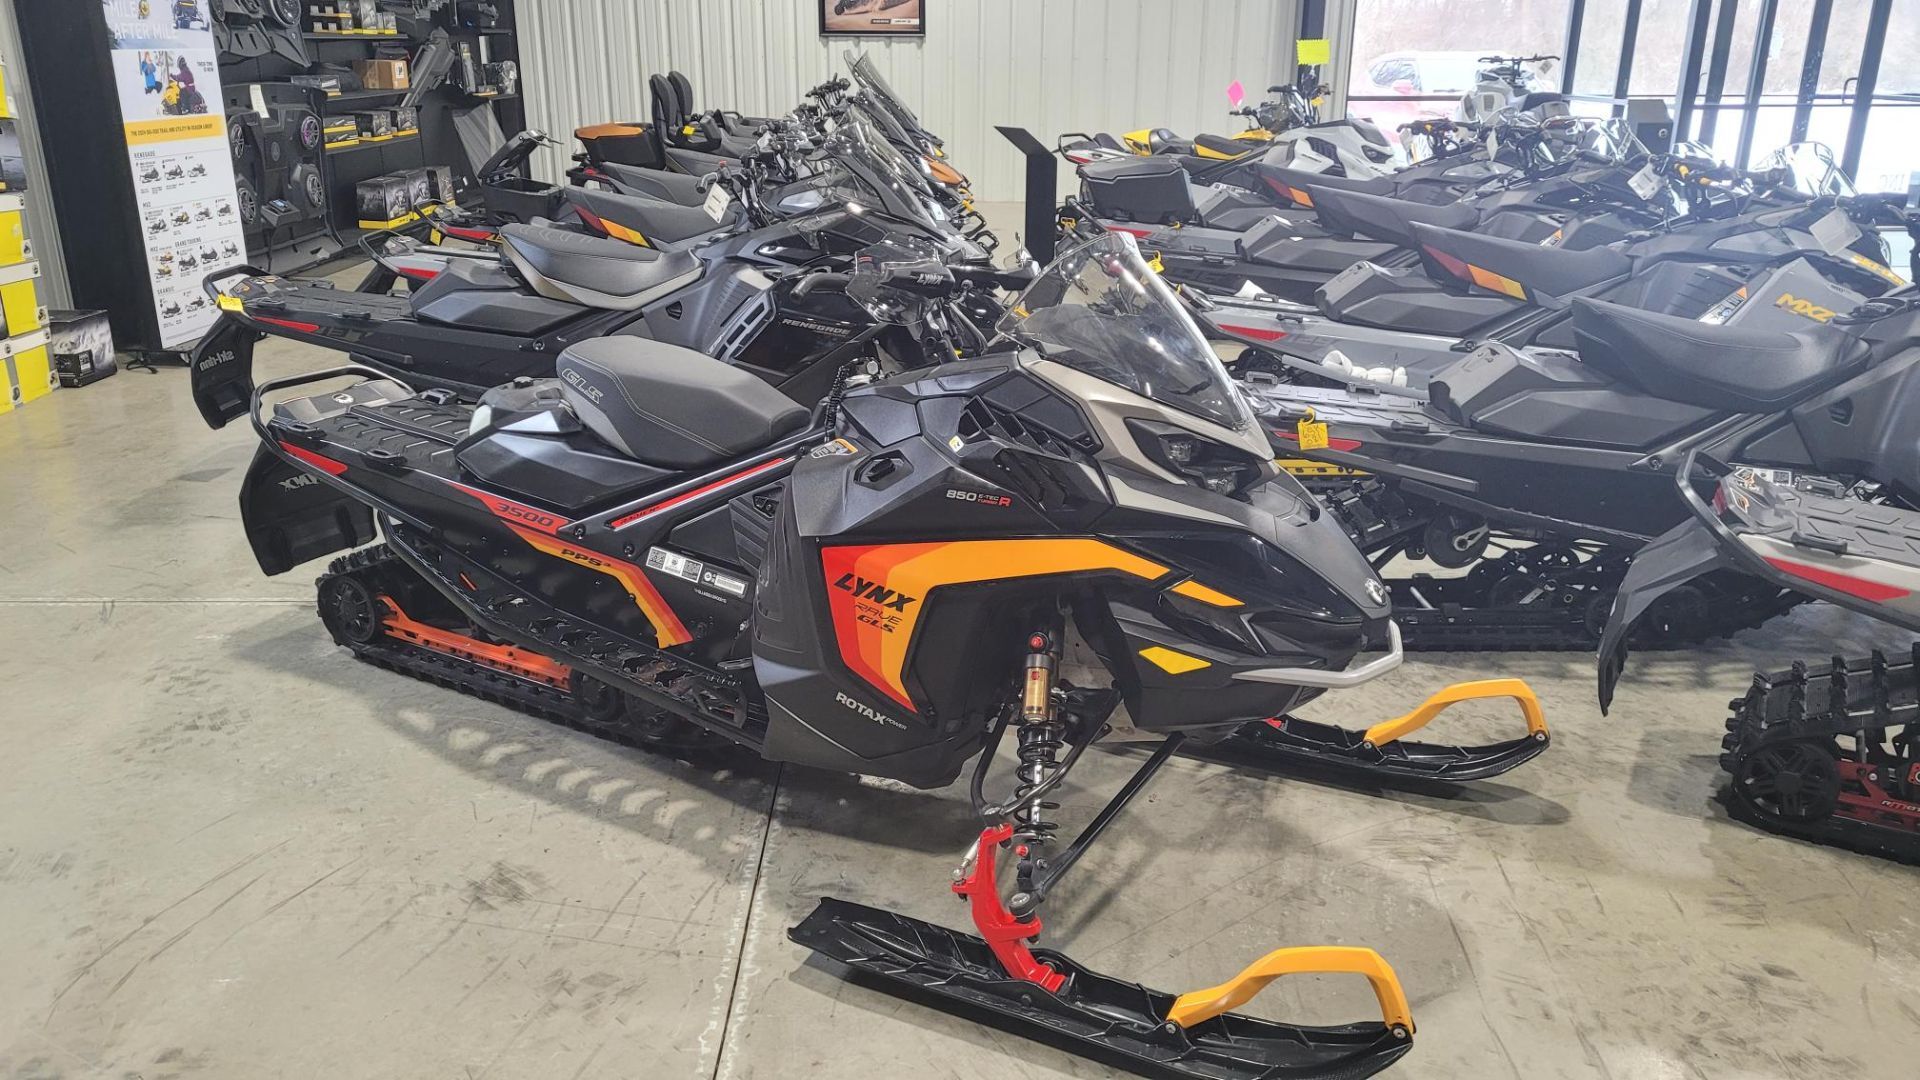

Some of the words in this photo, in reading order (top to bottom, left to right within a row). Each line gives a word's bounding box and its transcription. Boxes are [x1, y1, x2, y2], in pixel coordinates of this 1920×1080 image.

[114, 22, 150, 39] AFTER
[916, 273, 944, 285] LYNX
[1775, 293, 1837, 324] MXZ
[782, 319, 851, 335] RENEGADE
[562, 368, 604, 404] GLS
[946, 489, 977, 501] 850
[496, 502, 554, 527] 3500
[834, 573, 916, 613] LYNX
[855, 602, 902, 625] RAVE
[857, 615, 895, 633] GLS
[836, 691, 887, 725] ROTAX
[885, 717, 907, 730] POWER
